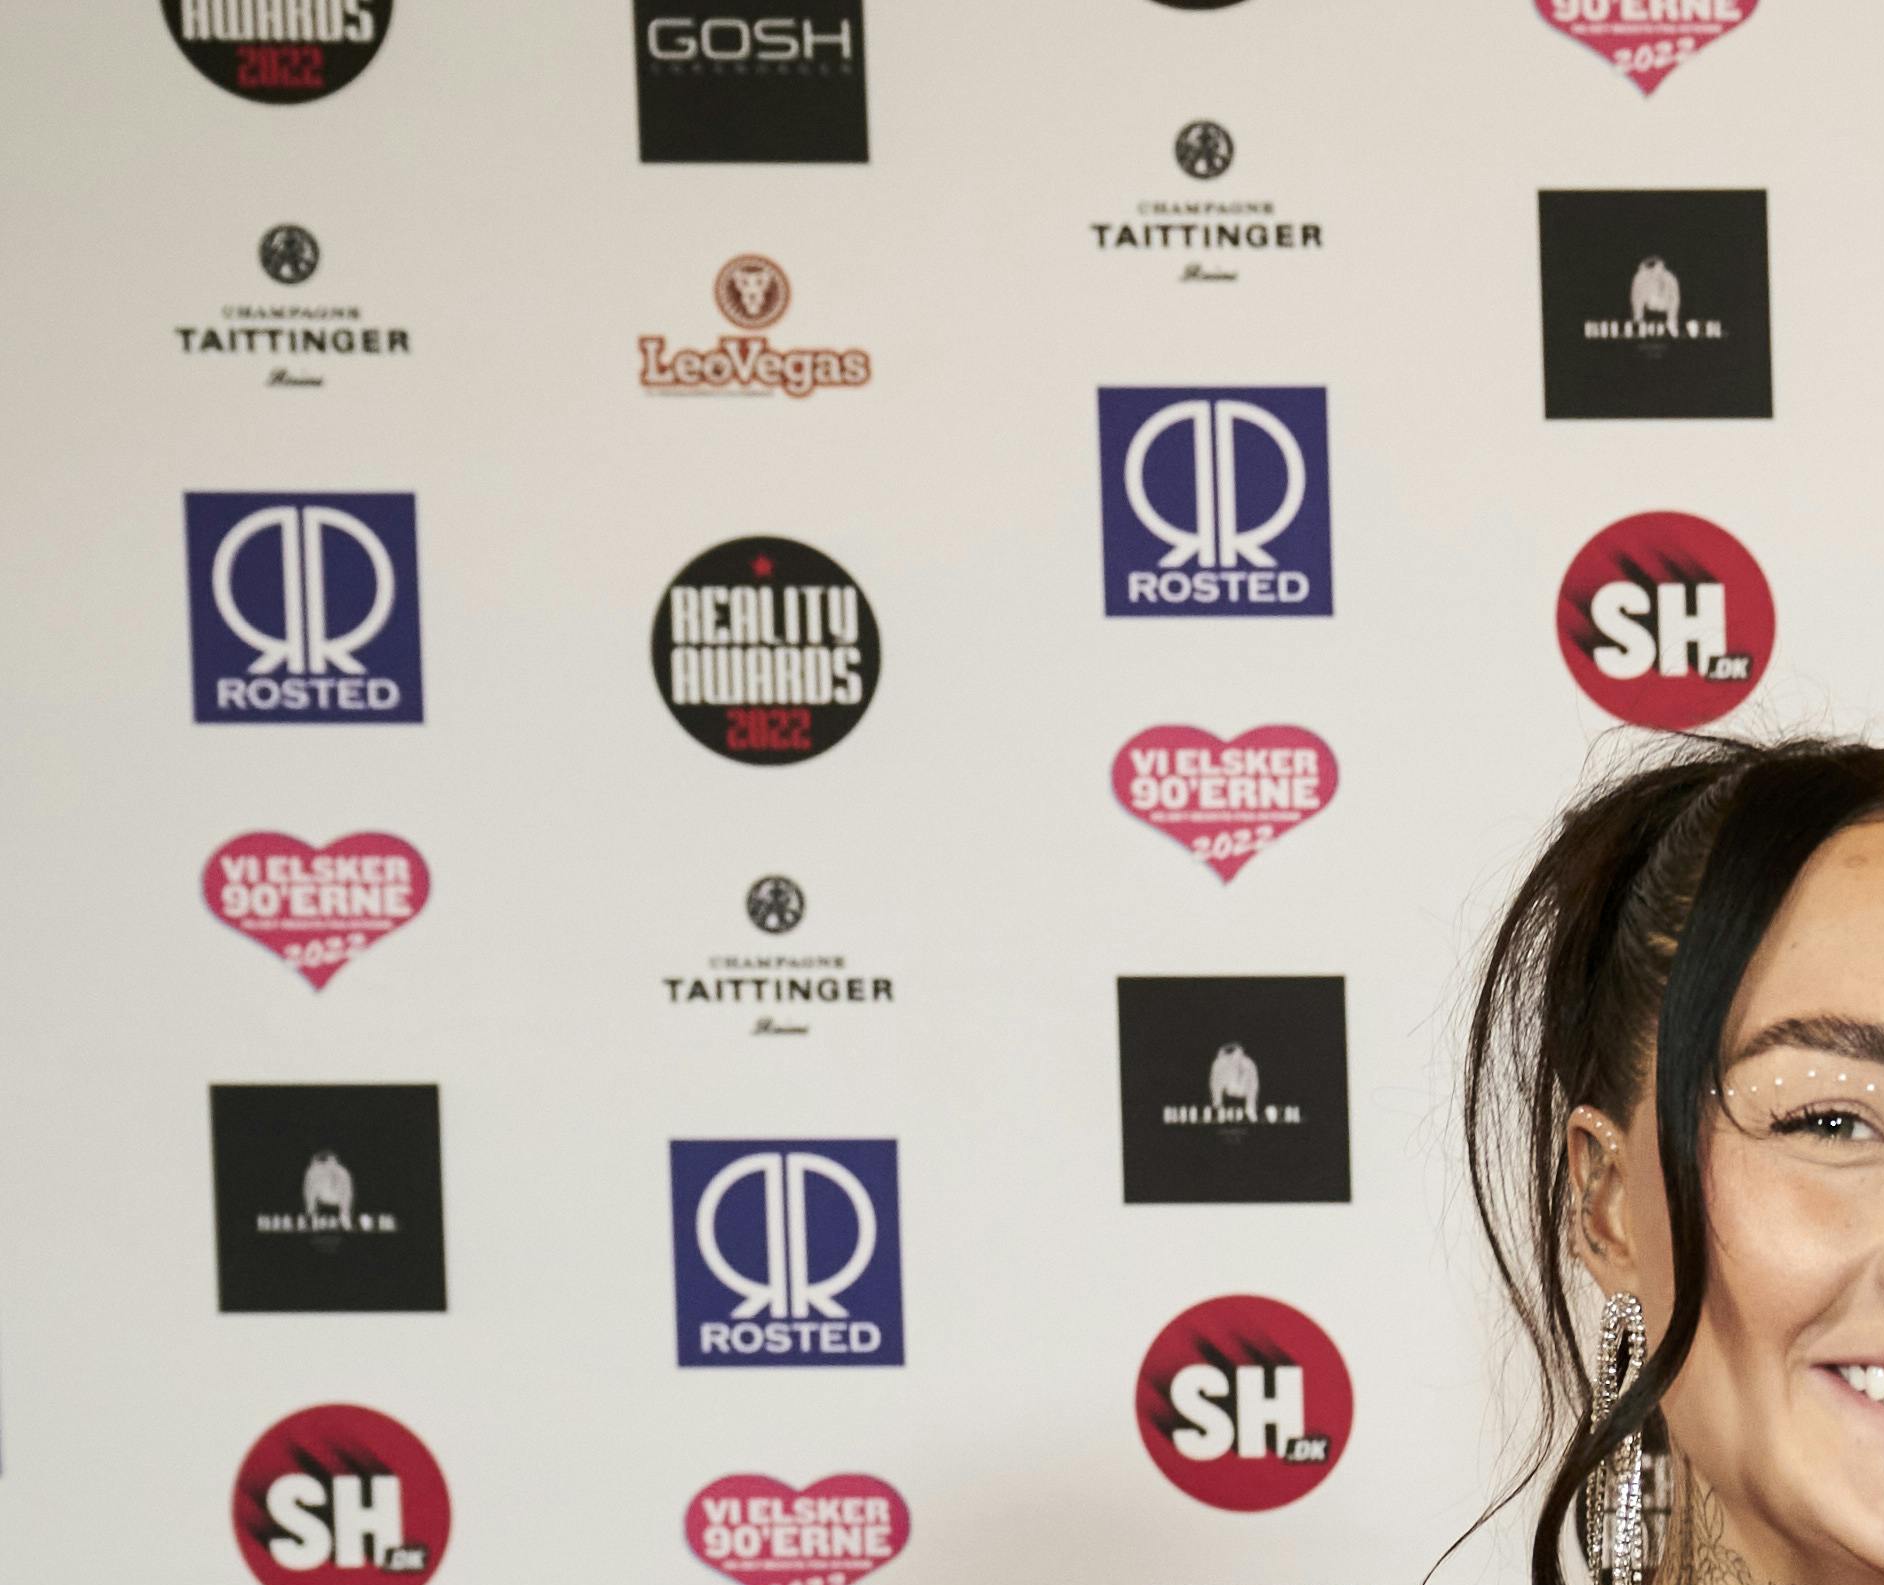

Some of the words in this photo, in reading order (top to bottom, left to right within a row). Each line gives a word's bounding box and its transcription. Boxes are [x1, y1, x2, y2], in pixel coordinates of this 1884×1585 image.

[181, 0, 374, 42] AWARDS
[647, 18, 852, 60] GOSH
[237, 45, 324, 87] 2022
[1615, 37, 1699, 75] 2022
[1139, 202, 1274, 215] CHAMPAGNE
[1092, 224, 1322, 248] TAITTINGER
[176, 328, 409, 353] TAITTINGER
[638, 336, 874, 400] LeoVegas
[1128, 571, 1310, 603] ROSTED
[671, 586, 858, 645] REALITY
[671, 646, 862, 705] AWARDS
[217, 678, 400, 710] ROSTED
[726, 708, 812, 749] 2022
[1130, 749, 1171, 776] VI
[1173, 748, 1318, 776] ELSKER
[1130, 778, 1319, 810] 90'ERNE
[1194, 825, 1276, 861] 2022
[221, 856, 261, 884] VI
[266, 856, 410, 884] ELSKER
[220, 884, 412, 916] 90'ERNE
[285, 933, 369, 970] 2022
[710, 956, 845, 969] CHAMPAGNE
[664, 978, 893, 1002] TAITTINGER
[700, 1321, 882, 1354] ROSTED
[702, 1498, 743, 1524] VI
[746, 1497, 890, 1524] ELSKER
[702, 1525, 891, 1559] 90'ERNE
